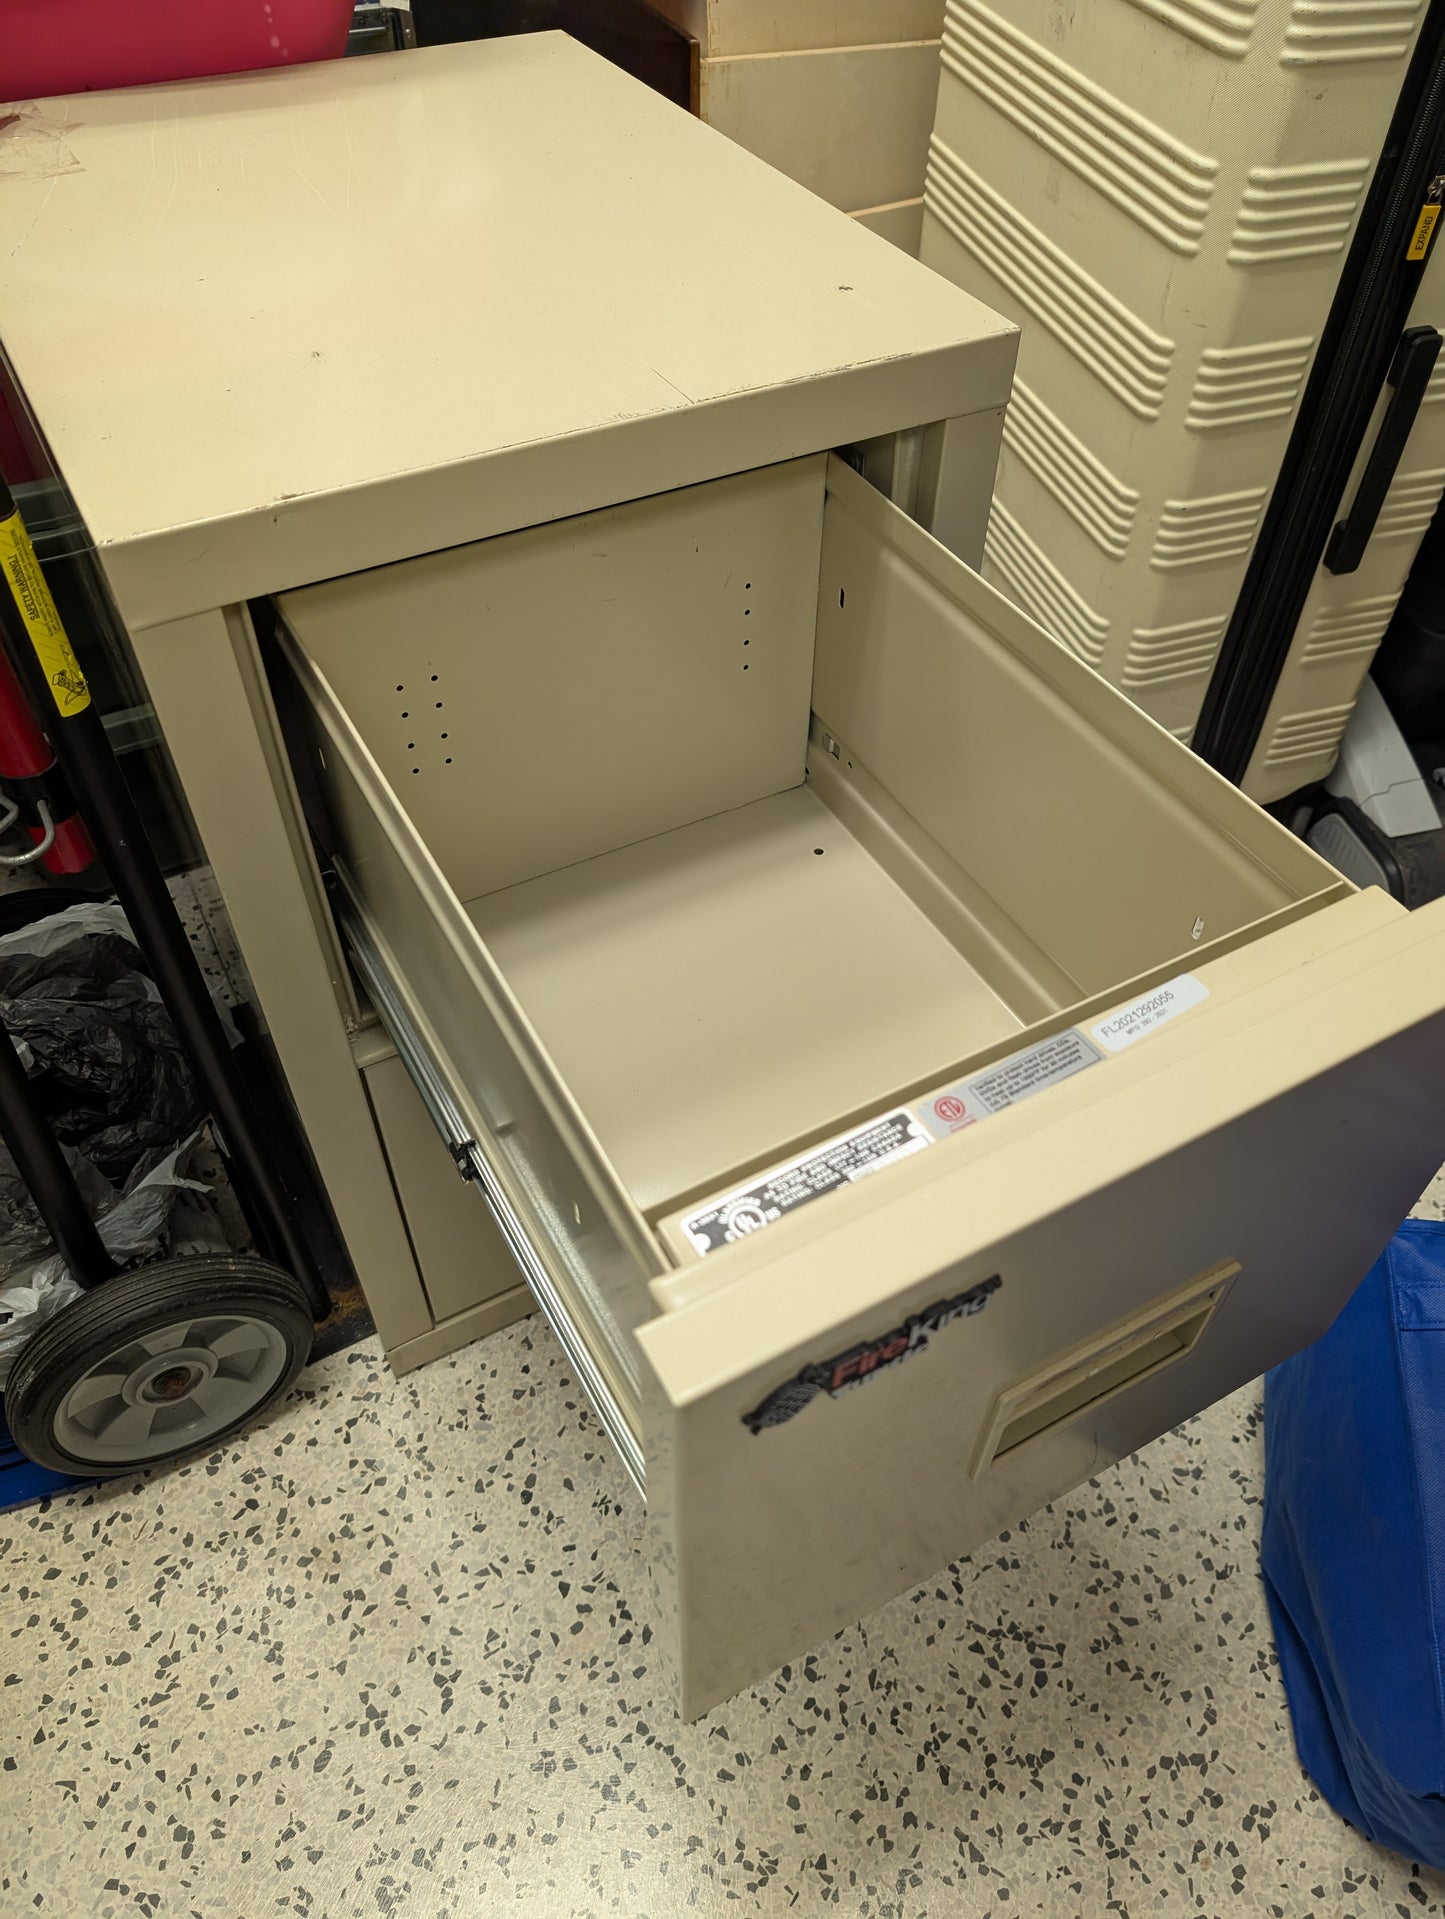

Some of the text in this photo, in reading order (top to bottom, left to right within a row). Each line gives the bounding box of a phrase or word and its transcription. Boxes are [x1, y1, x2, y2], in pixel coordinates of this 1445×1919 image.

[1415, 216, 1433, 251] EXPAND
[23, 594, 40, 621] SAFETY
[1101, 991, 1174, 1037] FL2021292055
[832, 1292, 992, 1388] FireKing
